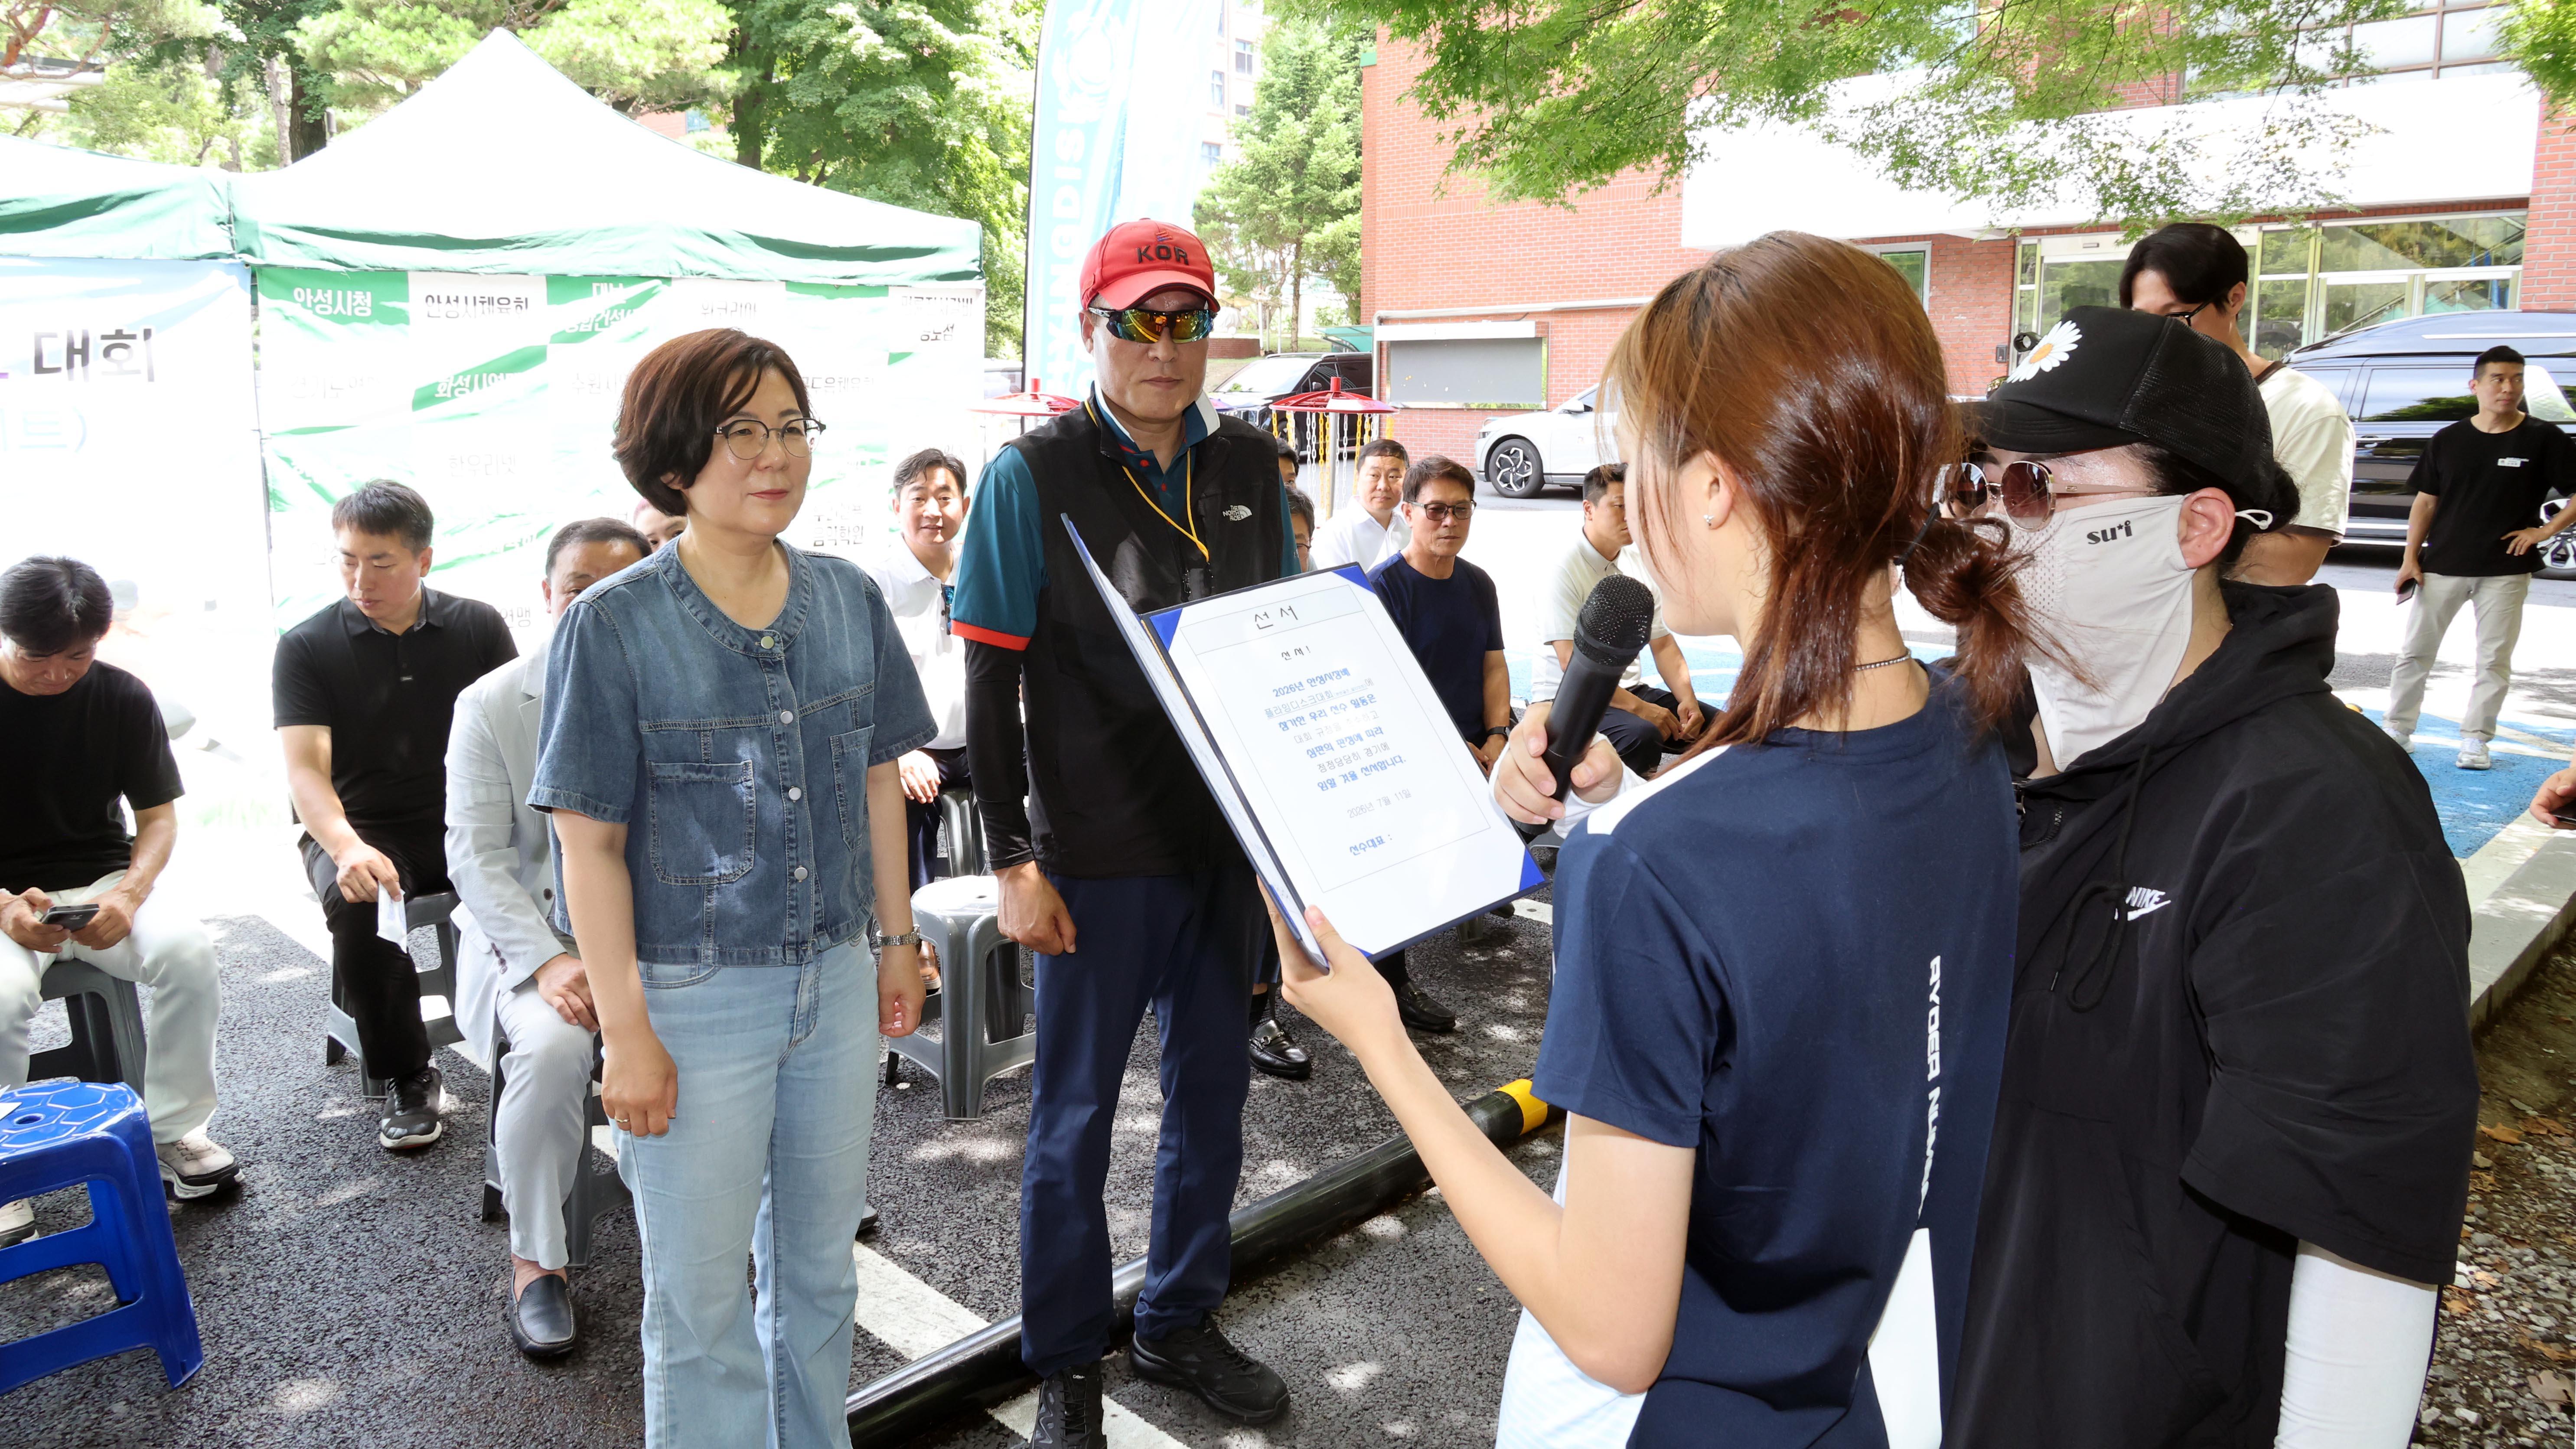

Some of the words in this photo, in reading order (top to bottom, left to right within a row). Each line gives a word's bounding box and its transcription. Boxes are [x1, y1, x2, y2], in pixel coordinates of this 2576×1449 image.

[1137, 245, 1189, 265] KOR
[293, 287, 372, 317] 안성시청
[33, 328, 156, 382] 대회
[812, 525, 864, 547] 음악학원
[1255, 611, 1273, 630] 선
[1280, 605, 1298, 620] 서
[1281, 651, 1291, 661] 선
[1294, 647, 1304, 656] 서
[1273, 681, 1305, 697] 2026년
[1306, 668, 1351, 688] 안성시장배
[1309, 709, 1328, 721] 우리
[1330, 702, 1348, 715] 선수
[1350, 694, 1377, 708] 일동은
[1294, 731, 1313, 744] 대회
[1315, 723, 1342, 738] 규정을
[1306, 742, 1334, 759] 심판의
[1336, 733, 1363, 748] 판정에
[1365, 726, 1384, 738] 따라
[1317, 751, 1362, 773] 정정당당히
[1363, 742, 1390, 757] 경기에
[1338, 770, 1359, 784] 것을
[1347, 802, 1375, 818] 2026년
[1377, 796, 1392, 808] 7월
[1394, 788, 1412, 801] 11일
[1350, 835, 1386, 856] 선수대표
[2125, 886, 2165, 908] NIKE
